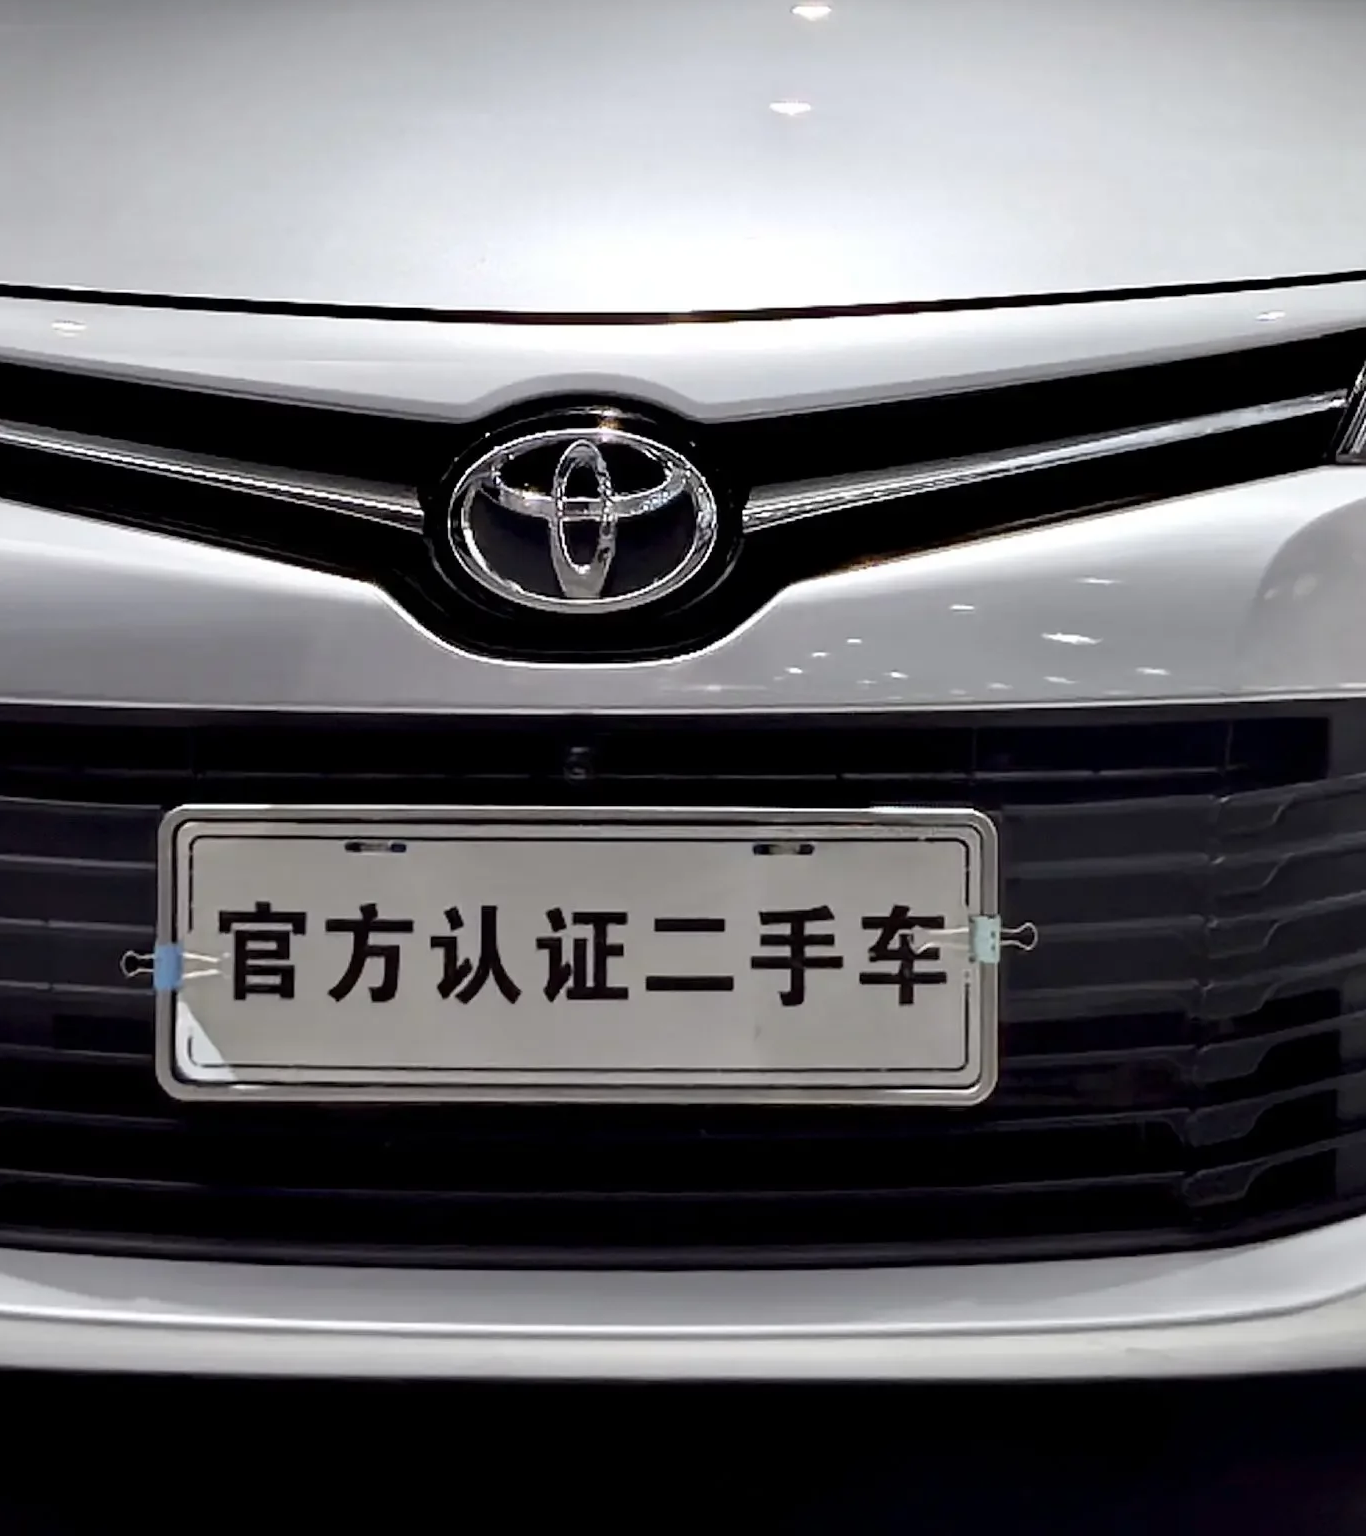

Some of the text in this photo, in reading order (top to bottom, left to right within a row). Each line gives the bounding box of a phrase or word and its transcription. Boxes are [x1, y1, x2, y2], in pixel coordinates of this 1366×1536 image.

[218, 901, 947, 1006] 官方认证二手车
